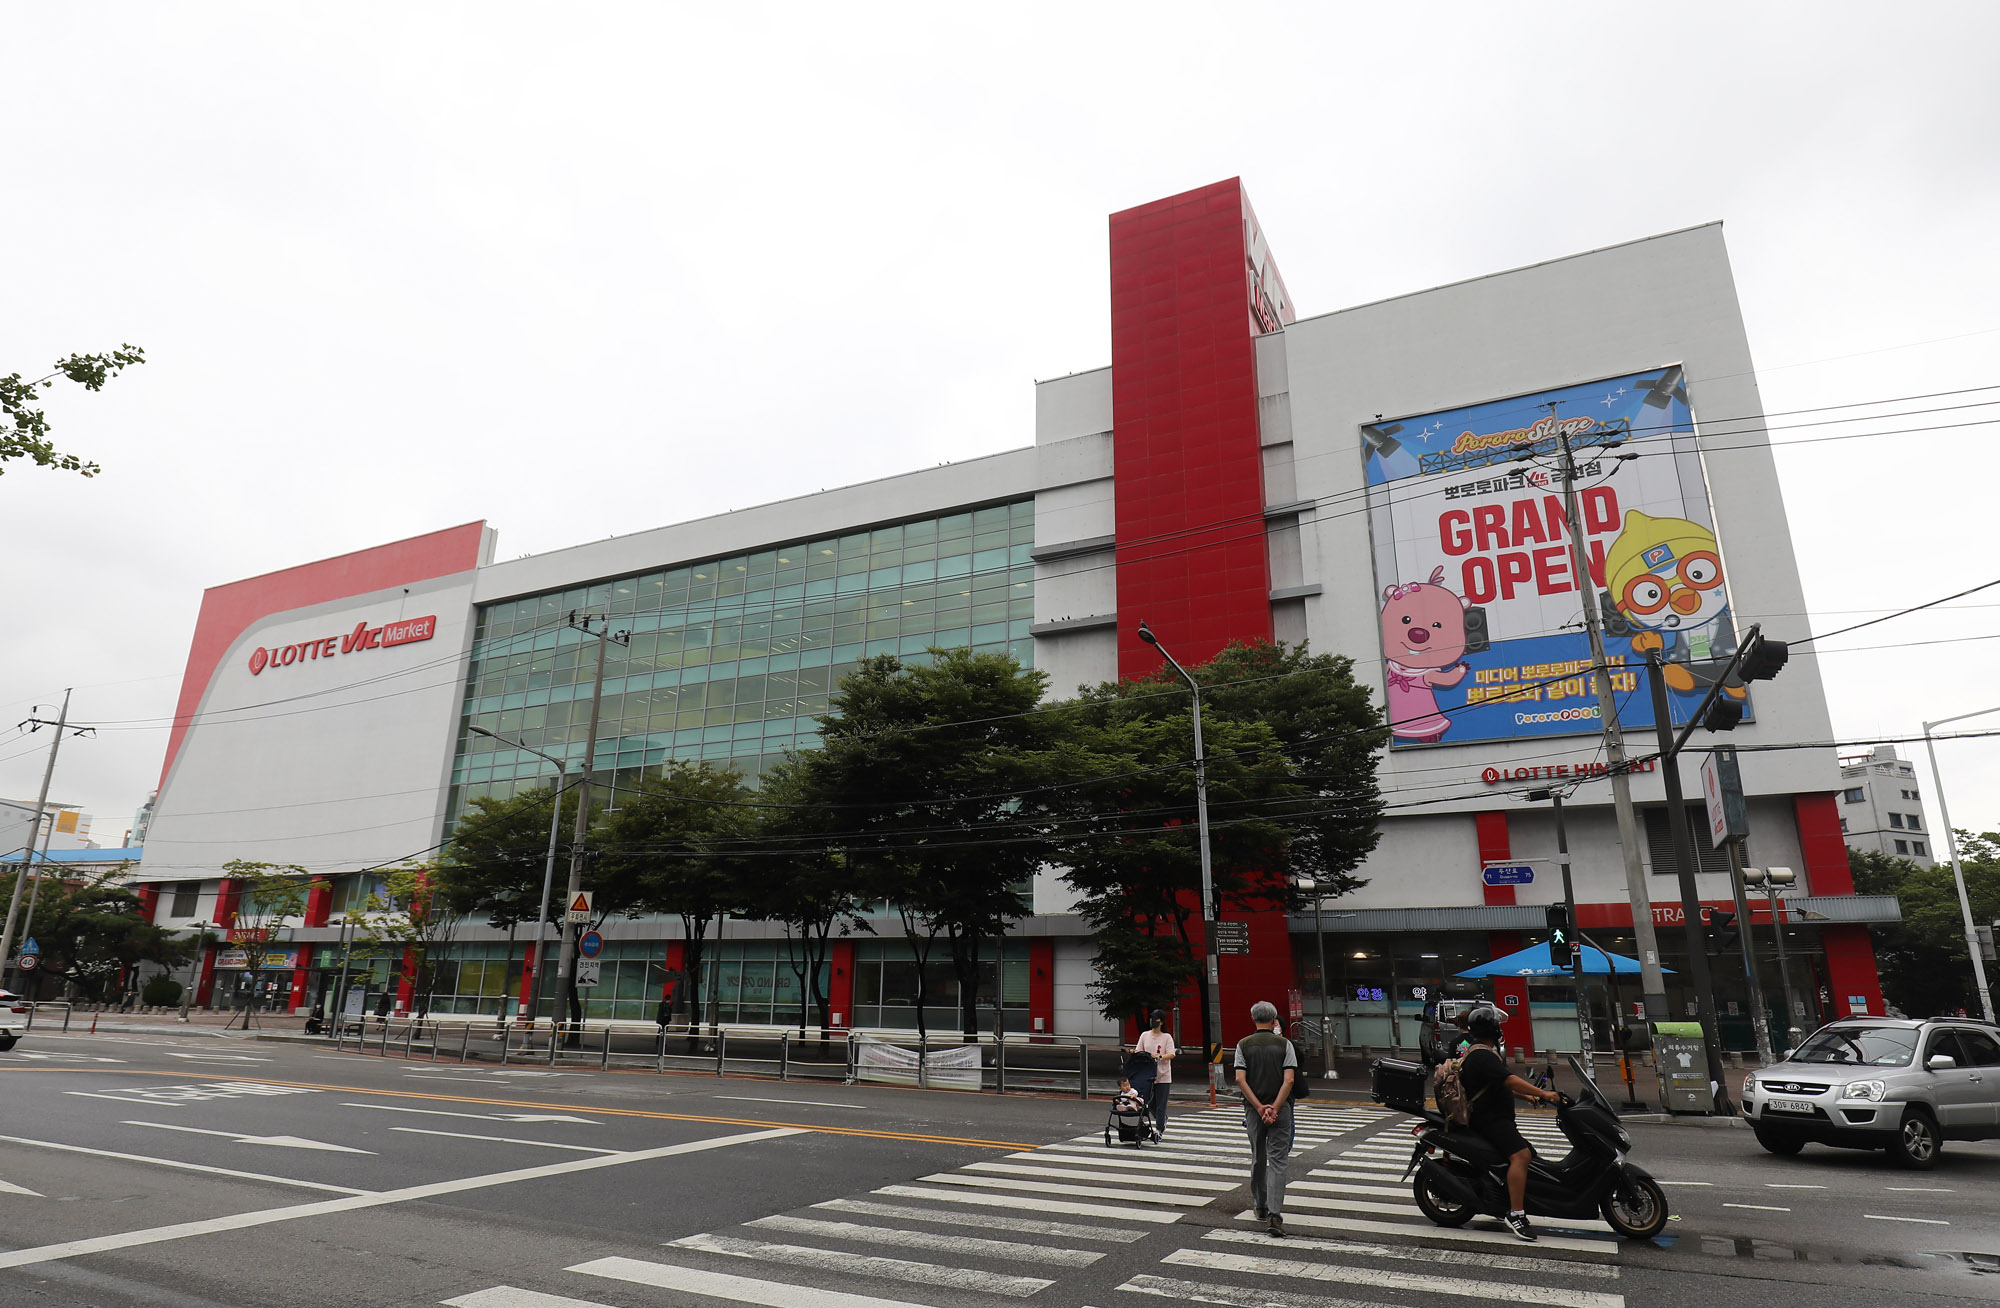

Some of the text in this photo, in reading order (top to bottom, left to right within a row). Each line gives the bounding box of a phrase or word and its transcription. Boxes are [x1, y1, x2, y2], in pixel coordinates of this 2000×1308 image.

[1445, 475, 1525, 500] 뽀로로파크
[1439, 486, 1621, 556] GRAND
[1461, 540, 1607, 605] OPEN
[269, 636, 338, 668] LOTTE
[385, 620, 430, 643] Market
[1475, 654, 1626, 684] 미디어 뽀로로파크서
[1466, 681, 1542, 706] 뽀로로와
[1546, 677, 1586, 700] 같이
[1504, 764, 1569, 781] LOTTE
[1357, 987, 1382, 1001] 안경
[1412, 987, 1427, 1001] 약
[1790, 1102, 1809, 1111] 6842
